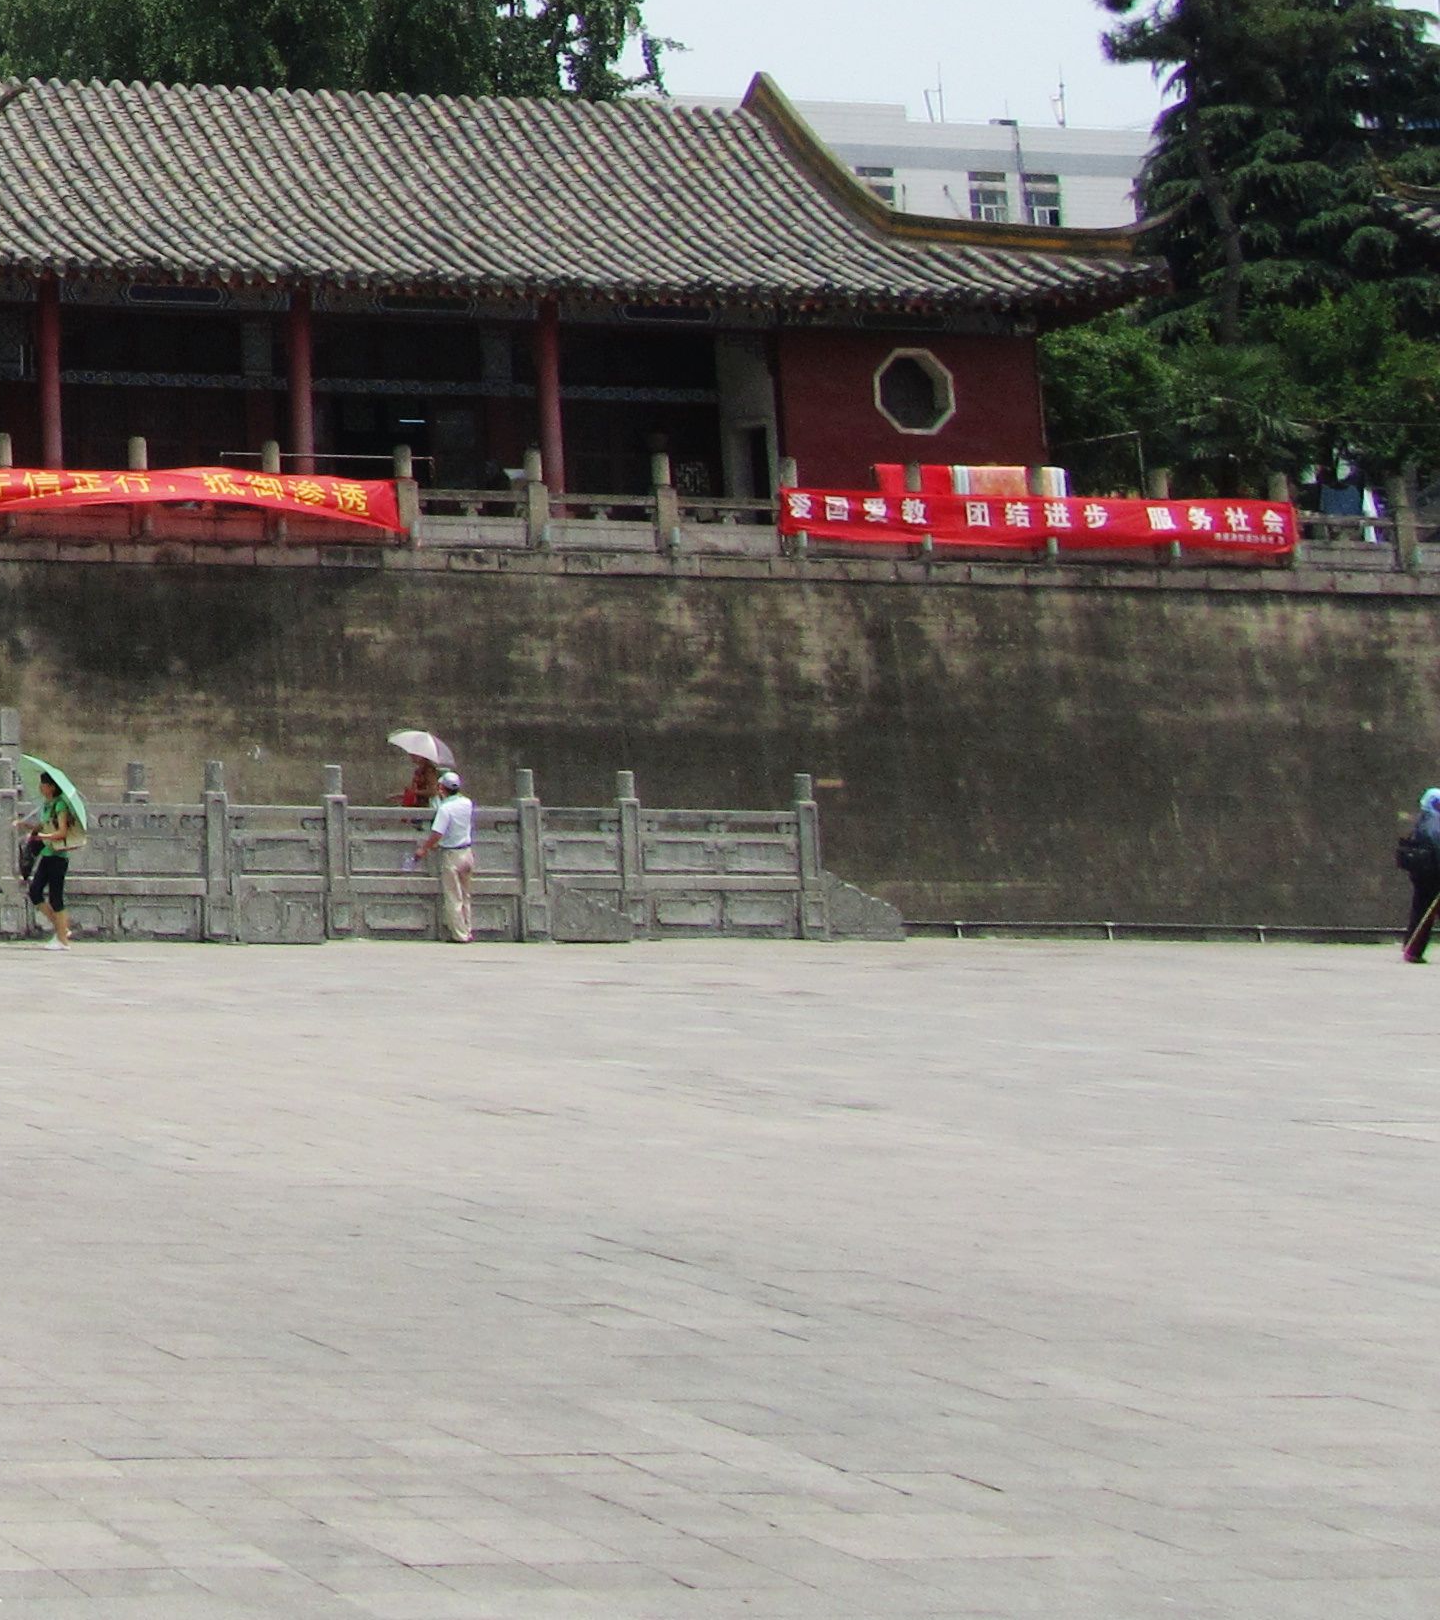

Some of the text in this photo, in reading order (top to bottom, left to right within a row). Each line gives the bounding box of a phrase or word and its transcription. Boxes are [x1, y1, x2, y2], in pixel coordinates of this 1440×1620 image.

[787, 493, 1286, 533] 爱国爱教 团结进步 服务社会
